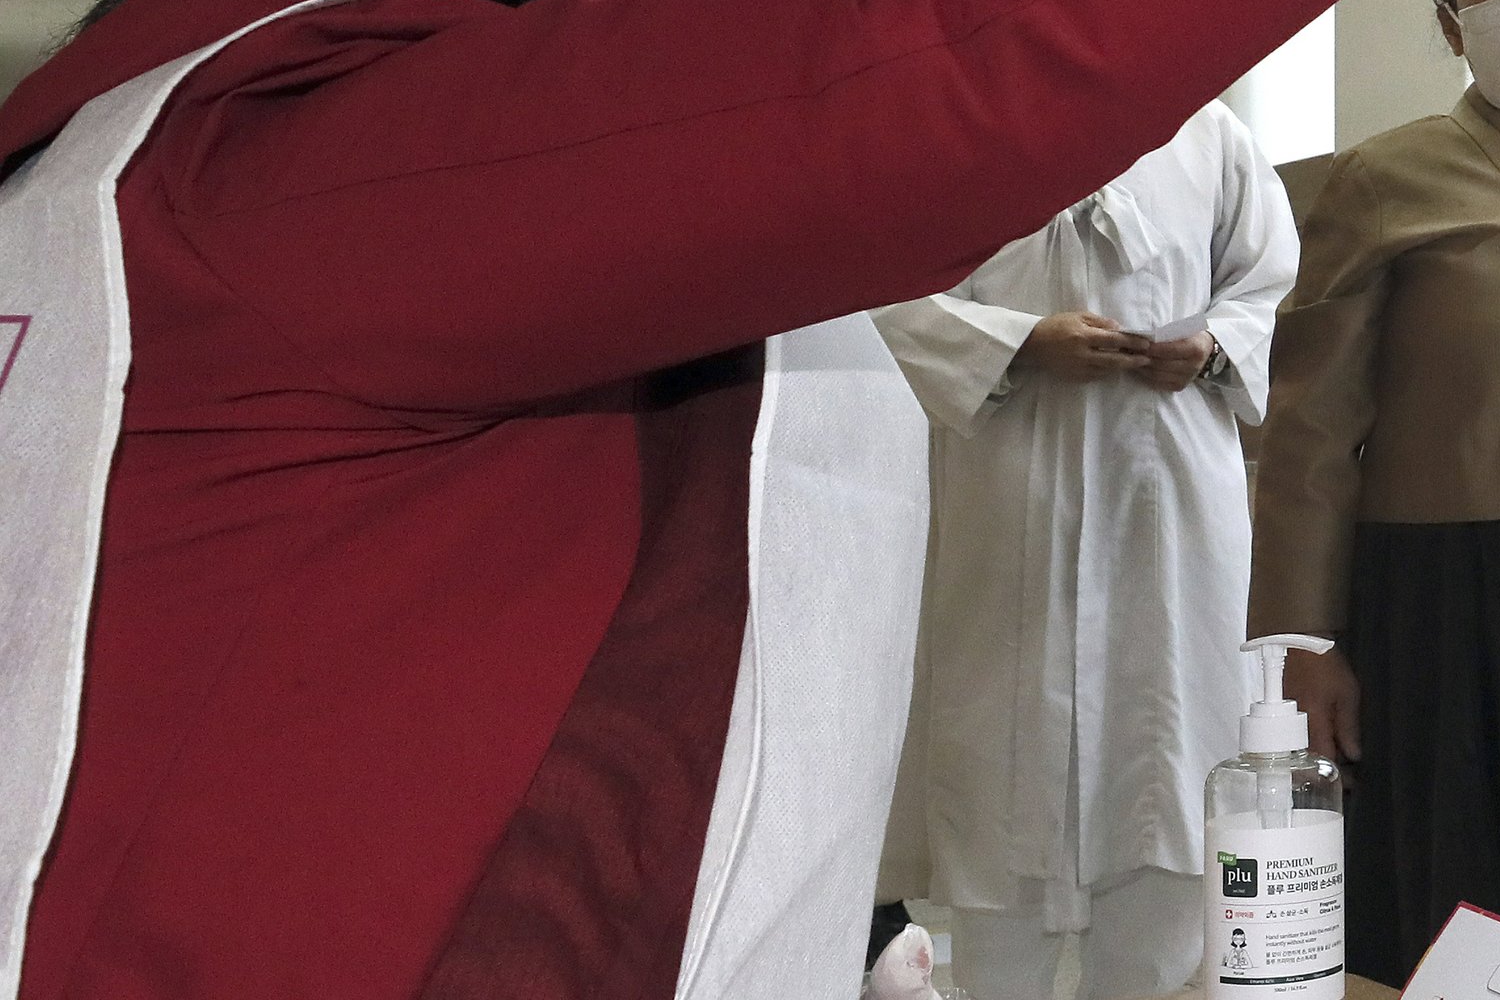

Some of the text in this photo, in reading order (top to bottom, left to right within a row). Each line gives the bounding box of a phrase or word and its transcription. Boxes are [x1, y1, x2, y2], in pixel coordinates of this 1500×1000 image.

[1266, 857, 1313, 869] PREMIUM
[1227, 867, 1252, 886] plu
[1266, 862, 1338, 881] HAND SANITIZER
[1286, 880, 1319, 893] 프리미엄
